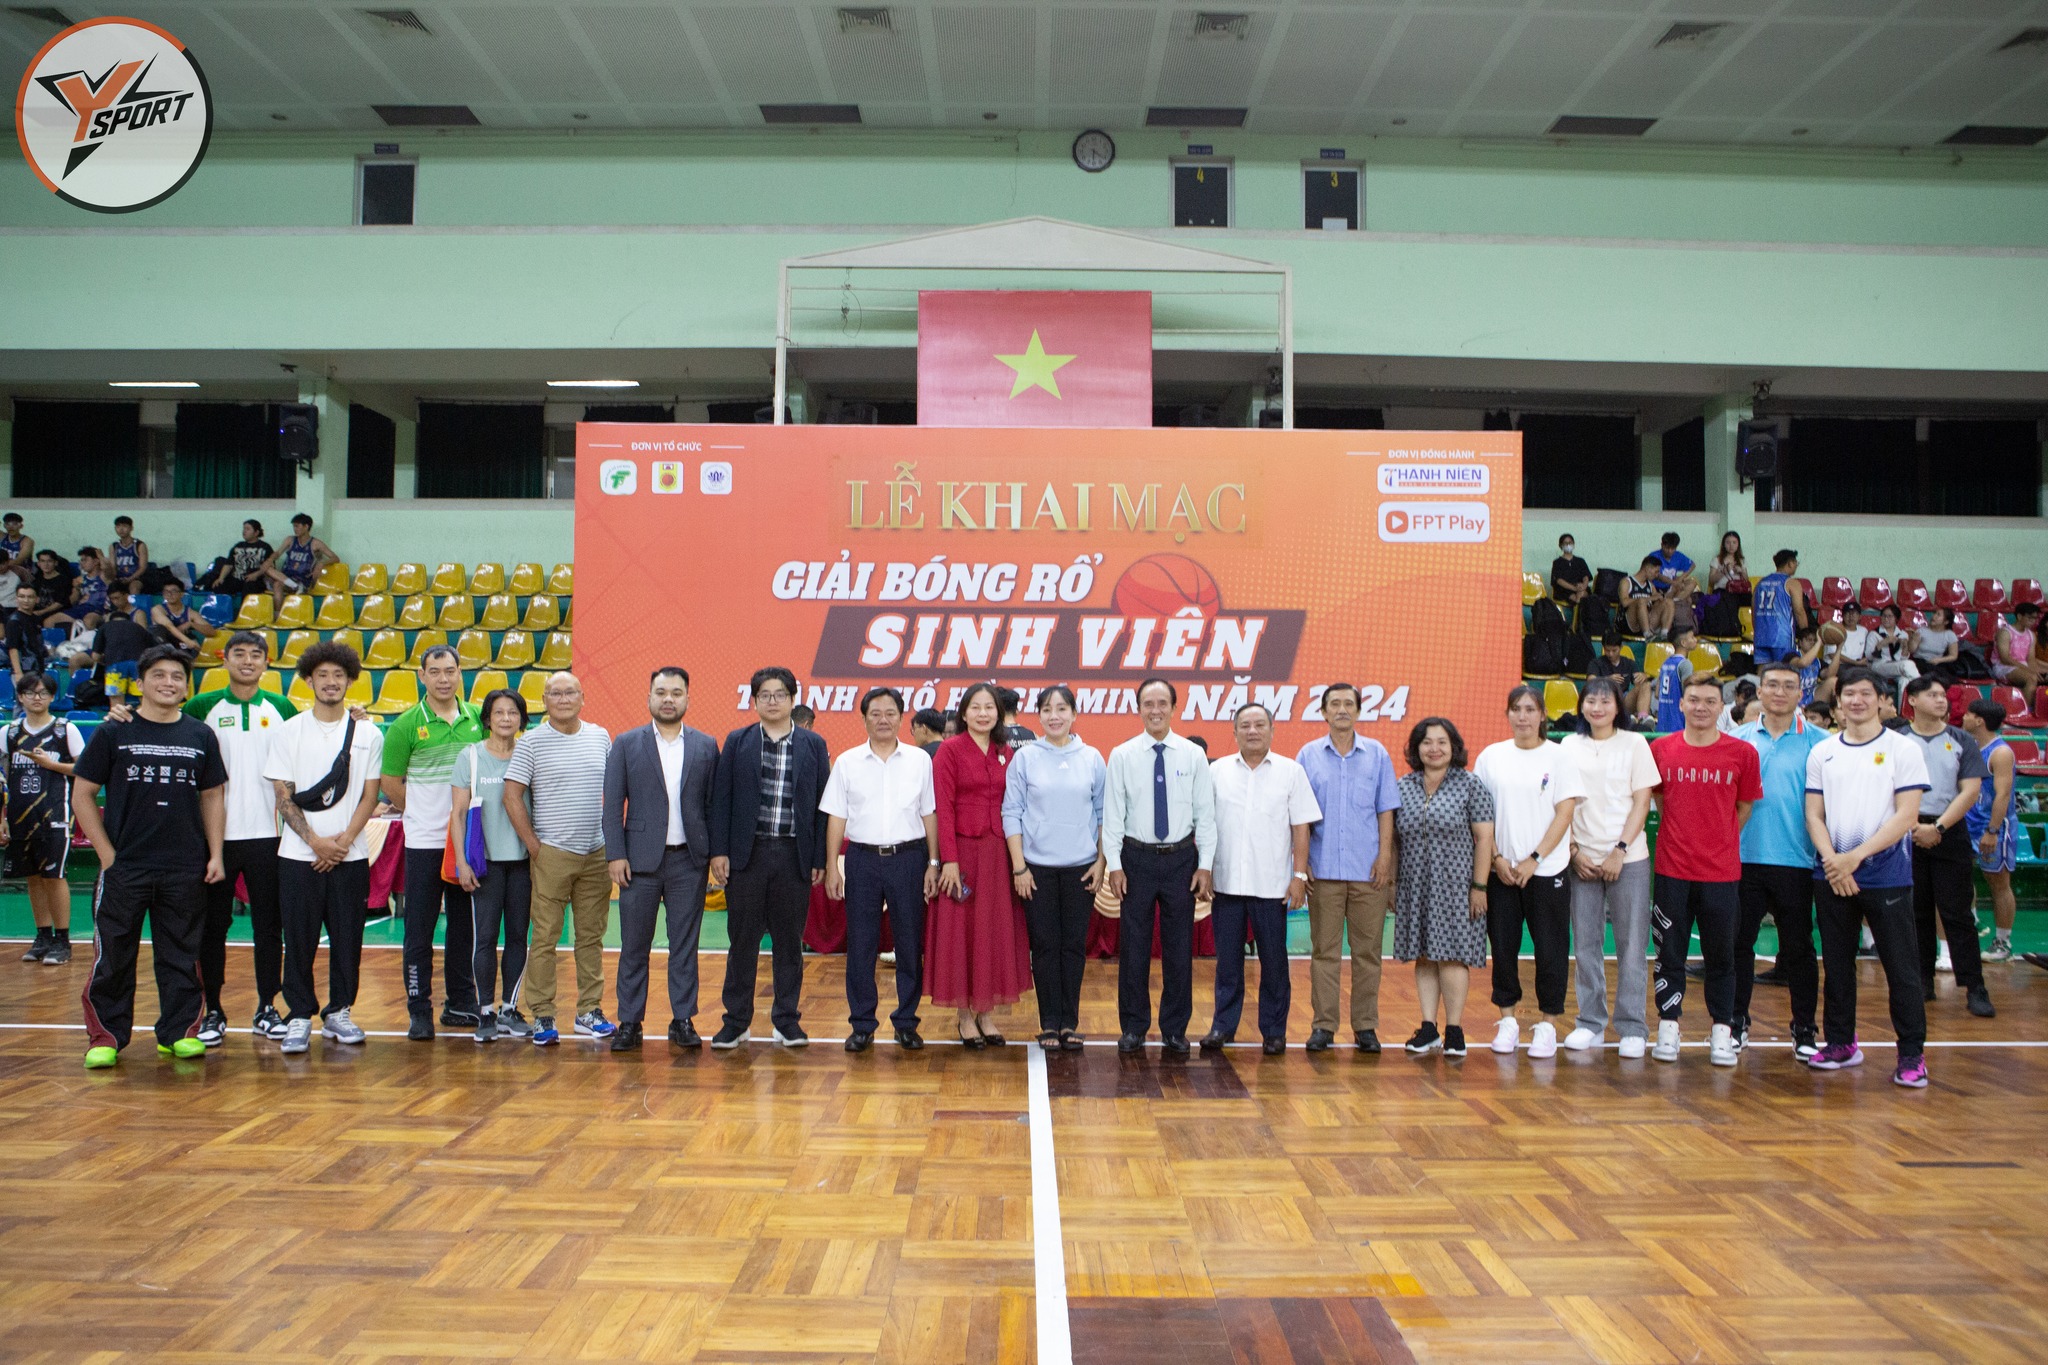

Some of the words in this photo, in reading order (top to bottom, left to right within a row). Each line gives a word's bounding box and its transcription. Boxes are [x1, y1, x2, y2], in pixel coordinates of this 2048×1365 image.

[1330, 171, 1339, 188] 3
[631, 441, 652, 451] ĐƠN
[652, 442, 662, 453] VỊ
[676, 440, 702, 452] CHỨC
[1388, 449, 1409, 459] ĐƠN
[1410, 449, 1419, 460] VỊ
[1448, 449, 1475, 459] HÀNH
[846, 461, 924, 529] LỄ
[937, 482, 1096, 532] KHAI
[1107, 483, 1246, 543] MẠC
[1413, 515, 1445, 530] FPT
[1449, 515, 1485, 534] Play
[772, 549, 875, 601] GIẢI
[879, 555, 1018, 602] BÓNG
[1024, 553, 1104, 602] RỔ
[1759, 590, 1776, 610] 17
[859, 613, 1058, 668] SINH
[1078, 606, 1268, 670] VIÊN
[737, 681, 858, 712] TNH
[1076, 686, 1139, 714] MIN
[1181, 676, 1298, 721] NĂM
[1301, 685, 1410, 722] 224
[480, 777, 503, 785] Reeb
[1667, 767, 1734, 785] JORDAN
[408, 964, 419, 996] NIKE
